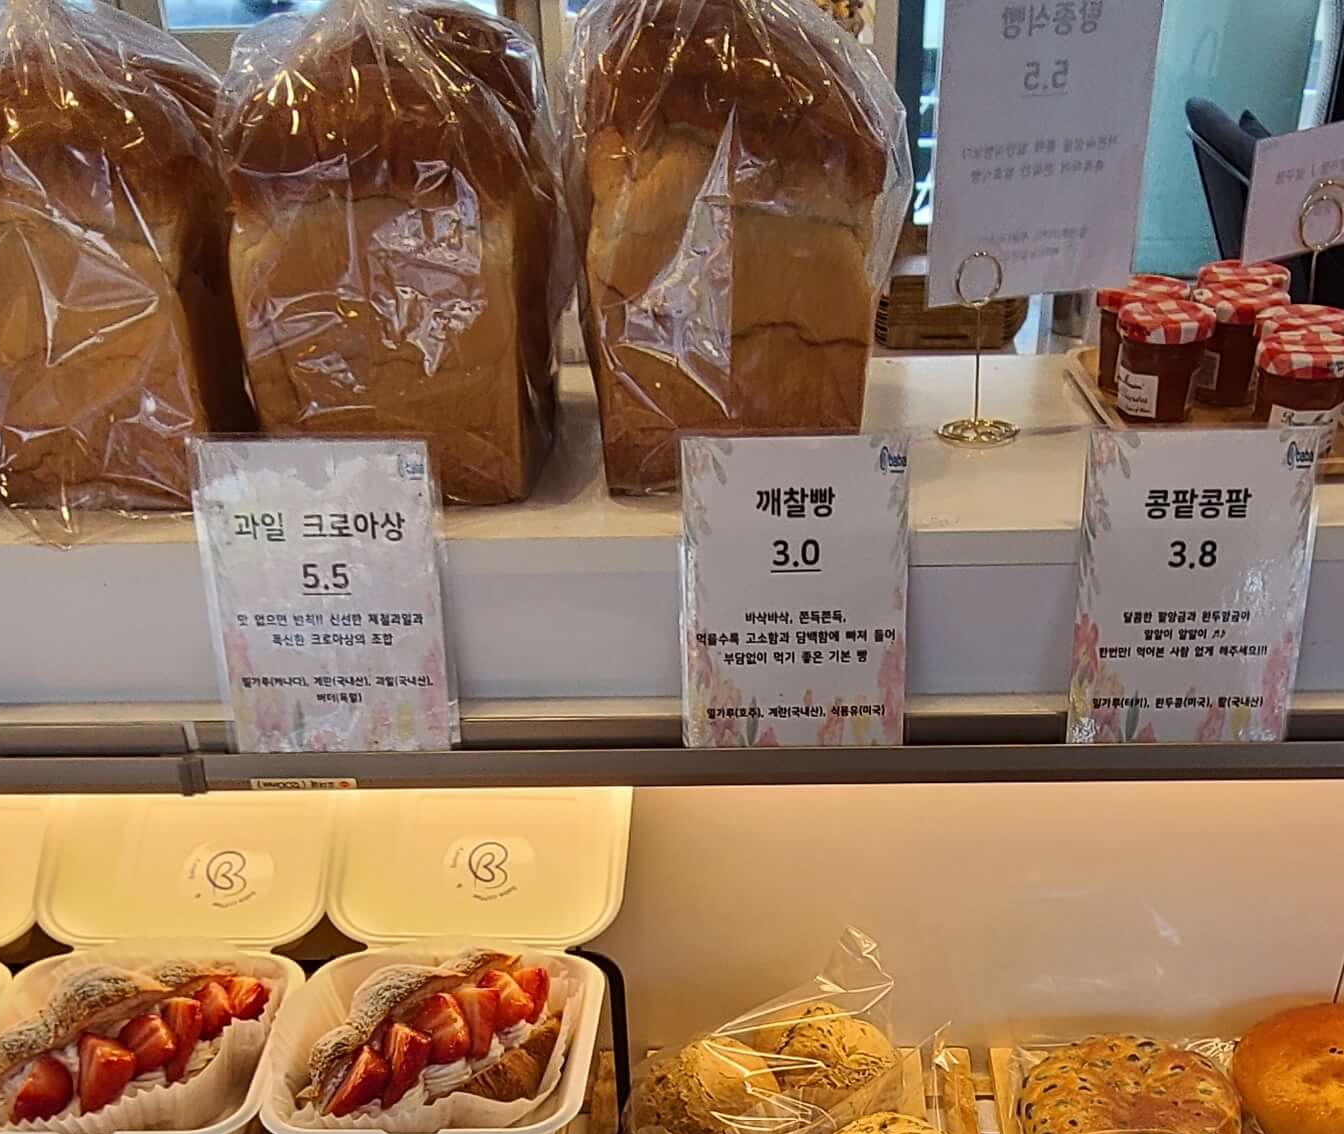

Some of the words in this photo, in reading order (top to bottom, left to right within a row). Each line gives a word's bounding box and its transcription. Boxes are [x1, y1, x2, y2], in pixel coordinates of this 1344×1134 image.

[755, 486, 836, 518] 깨찰빵
[1145, 487, 1253, 519] 콩팥콩팥
[233, 511, 287, 543] 과일
[302, 511, 407, 543] 크로아상
[772, 539, 821, 568] 3.0
[1167, 540, 1218, 569] 3.8
[302, 562, 351, 591] 5.5
[254, 613, 289, 626] 없으면
[330, 613, 363, 626] 신선한
[1123, 610, 1152, 624] 달콤한
[311, 633, 366, 647] 크로아상의
[371, 632, 394, 646] 조합
[745, 630, 790, 645] 고소함과
[795, 629, 841, 644] 담백함에
[873, 628, 896, 642] 들어
[723, 651, 768, 666] 부담없이
[773, 651, 796, 665] 먹기
[800, 650, 824, 664] 좋은
[828, 650, 852, 664] 기본
[1136, 646, 1165, 659] 먹어본
[1169, 645, 1190, 658] 사람
[1194, 645, 1214, 658] 없게
